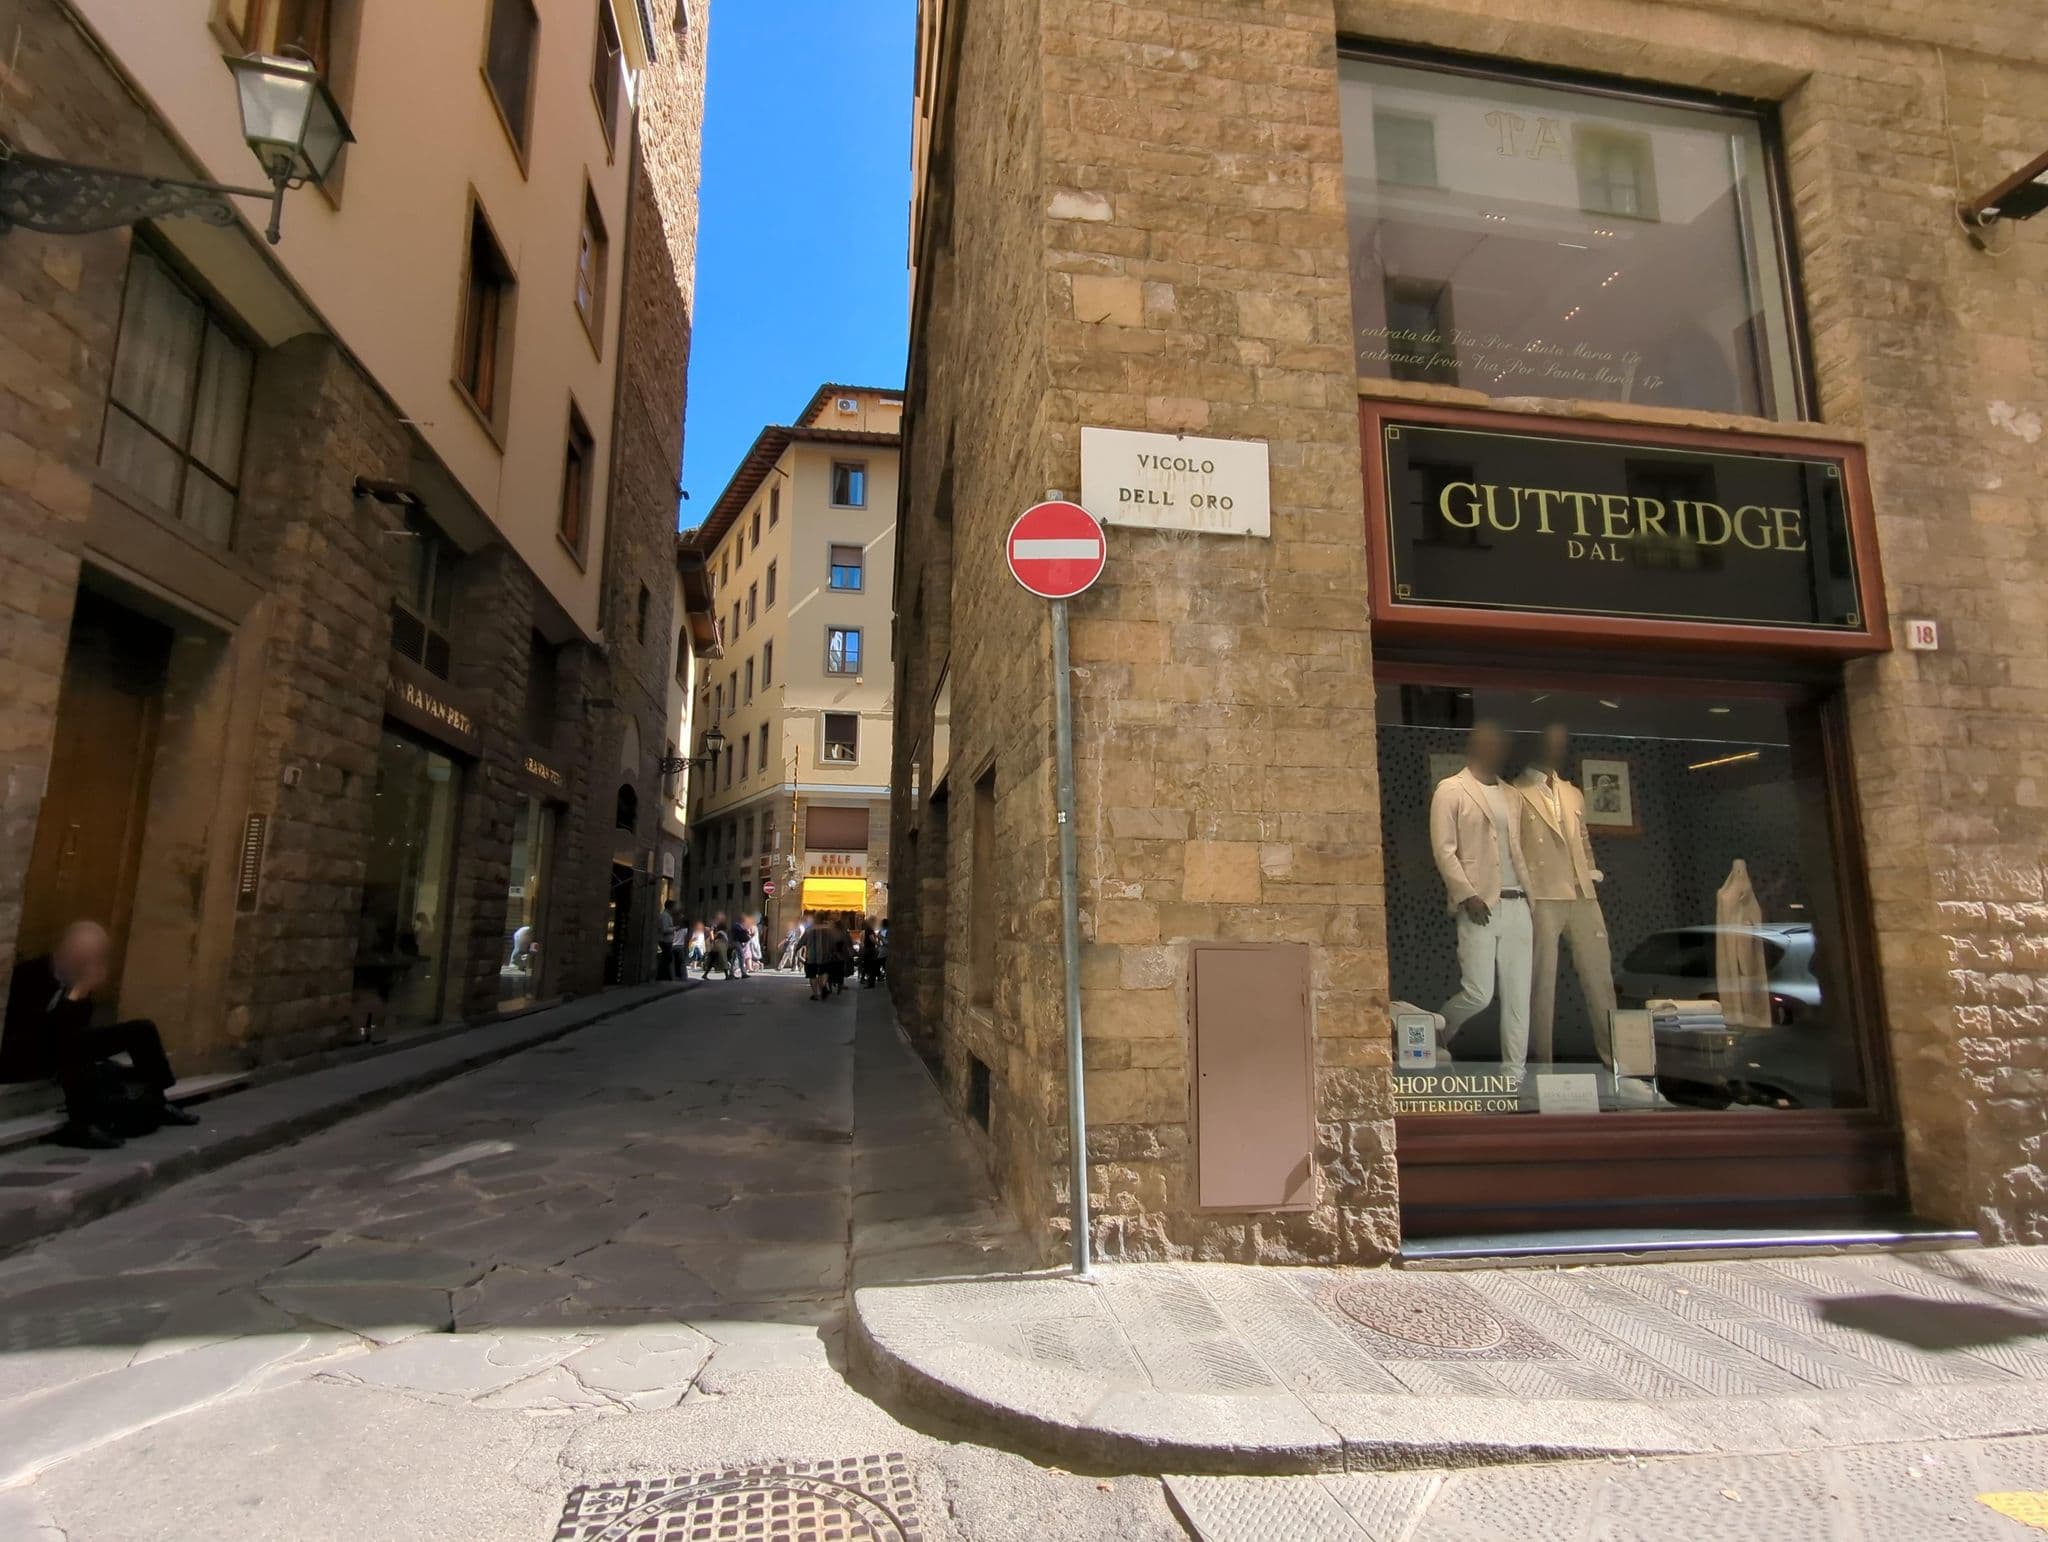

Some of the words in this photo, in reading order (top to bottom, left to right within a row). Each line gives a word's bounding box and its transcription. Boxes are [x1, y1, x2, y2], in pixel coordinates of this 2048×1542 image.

[1360, 327, 1417, 343] entrata
[1421, 329, 1441, 344] da
[1360, 348, 1424, 364] entrance
[1424, 351, 1463, 371] from
[1137, 454, 1215, 474] VICOLO
[1118, 487, 1174, 506] DELL
[1190, 493, 1234, 510] ORO
[1438, 480, 1807, 552] GUTTERIDGE
[1567, 539, 1625, 563] DAL
[1915, 624, 1935, 645] 18
[822, 854, 851, 865] SELF
[810, 865, 861, 876] SERVICE
[1391, 1075, 1438, 1094] SHOP
[1441, 1075, 1519, 1094] ONLINE
